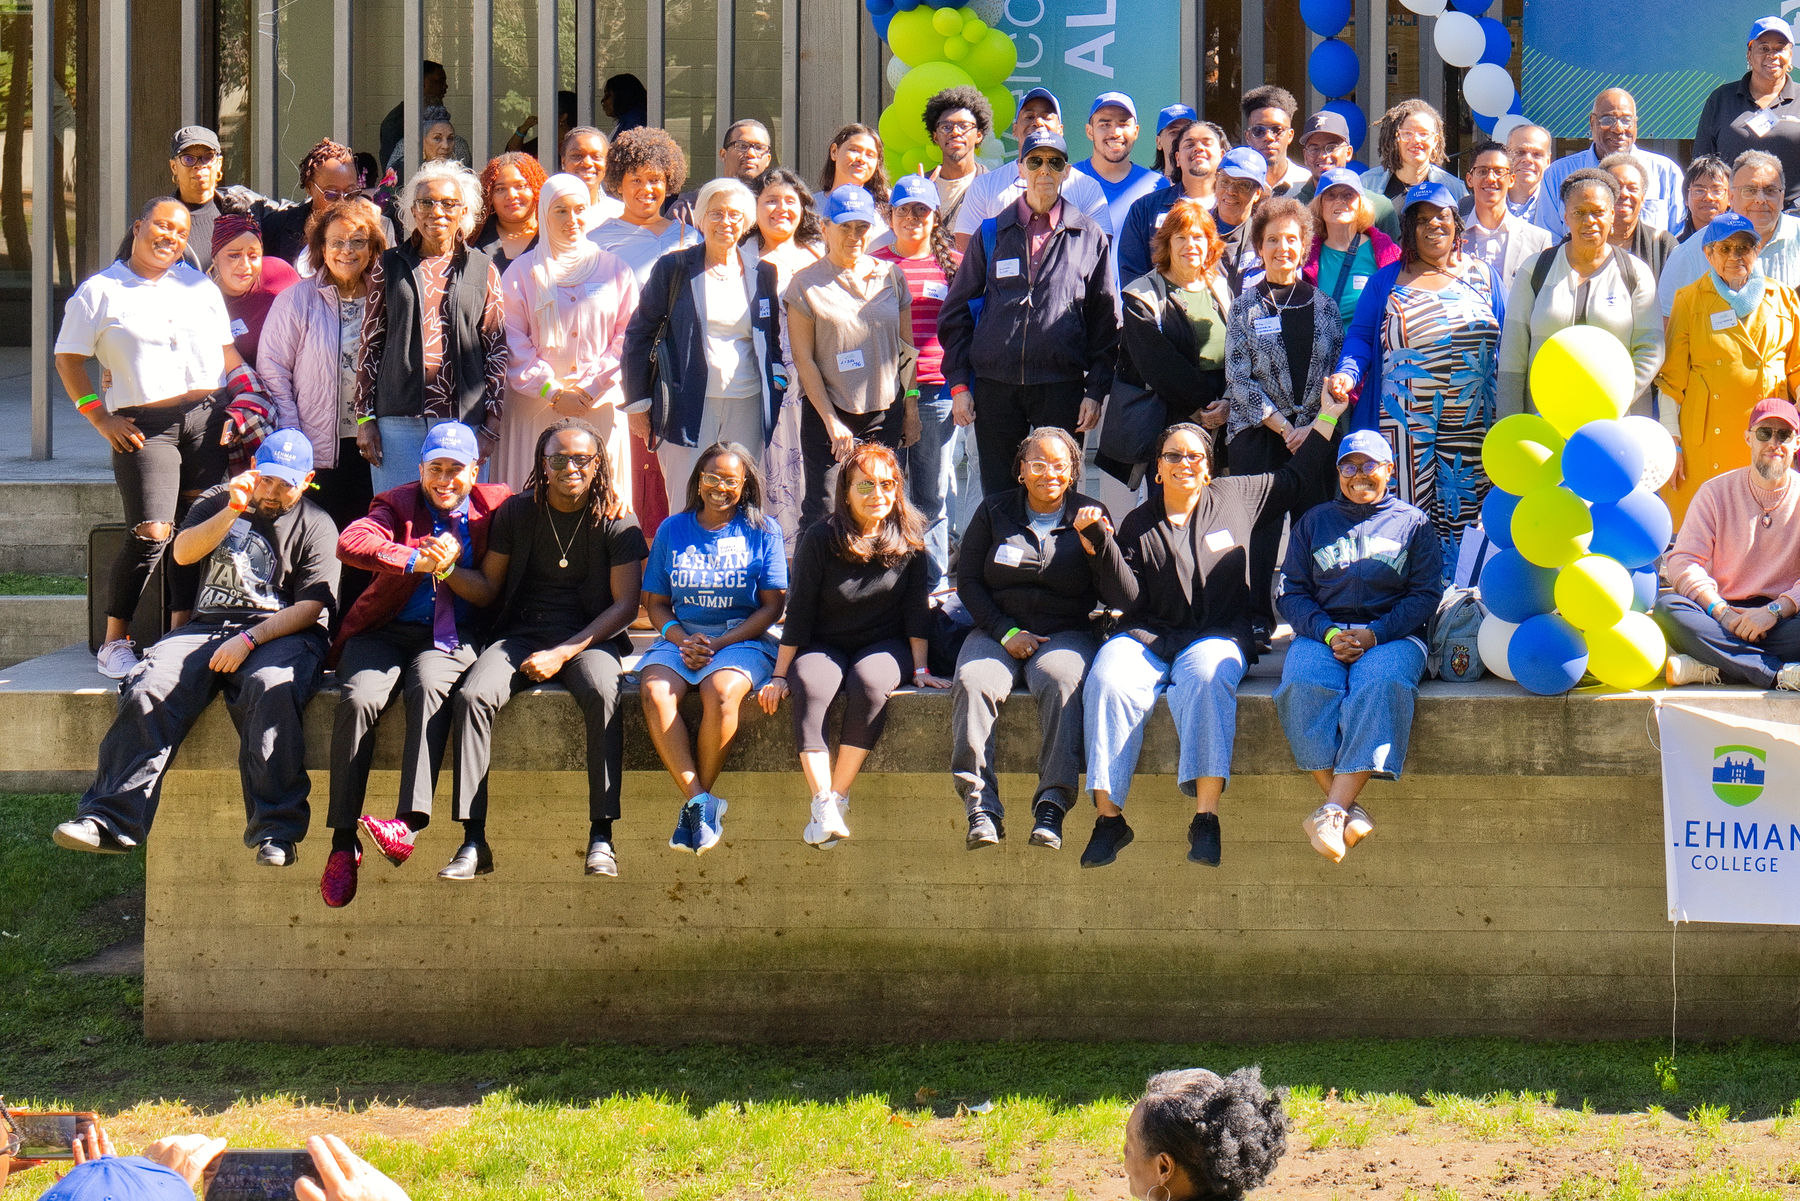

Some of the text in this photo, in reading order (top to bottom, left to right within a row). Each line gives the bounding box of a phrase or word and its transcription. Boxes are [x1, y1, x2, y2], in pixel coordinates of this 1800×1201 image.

[672, 550, 749, 569] LEHMAN
[670, 569, 747, 588] COLLEGE
[683, 595, 733, 608] ALUMNI
[1691, 855, 1778, 872] COLLEGE
